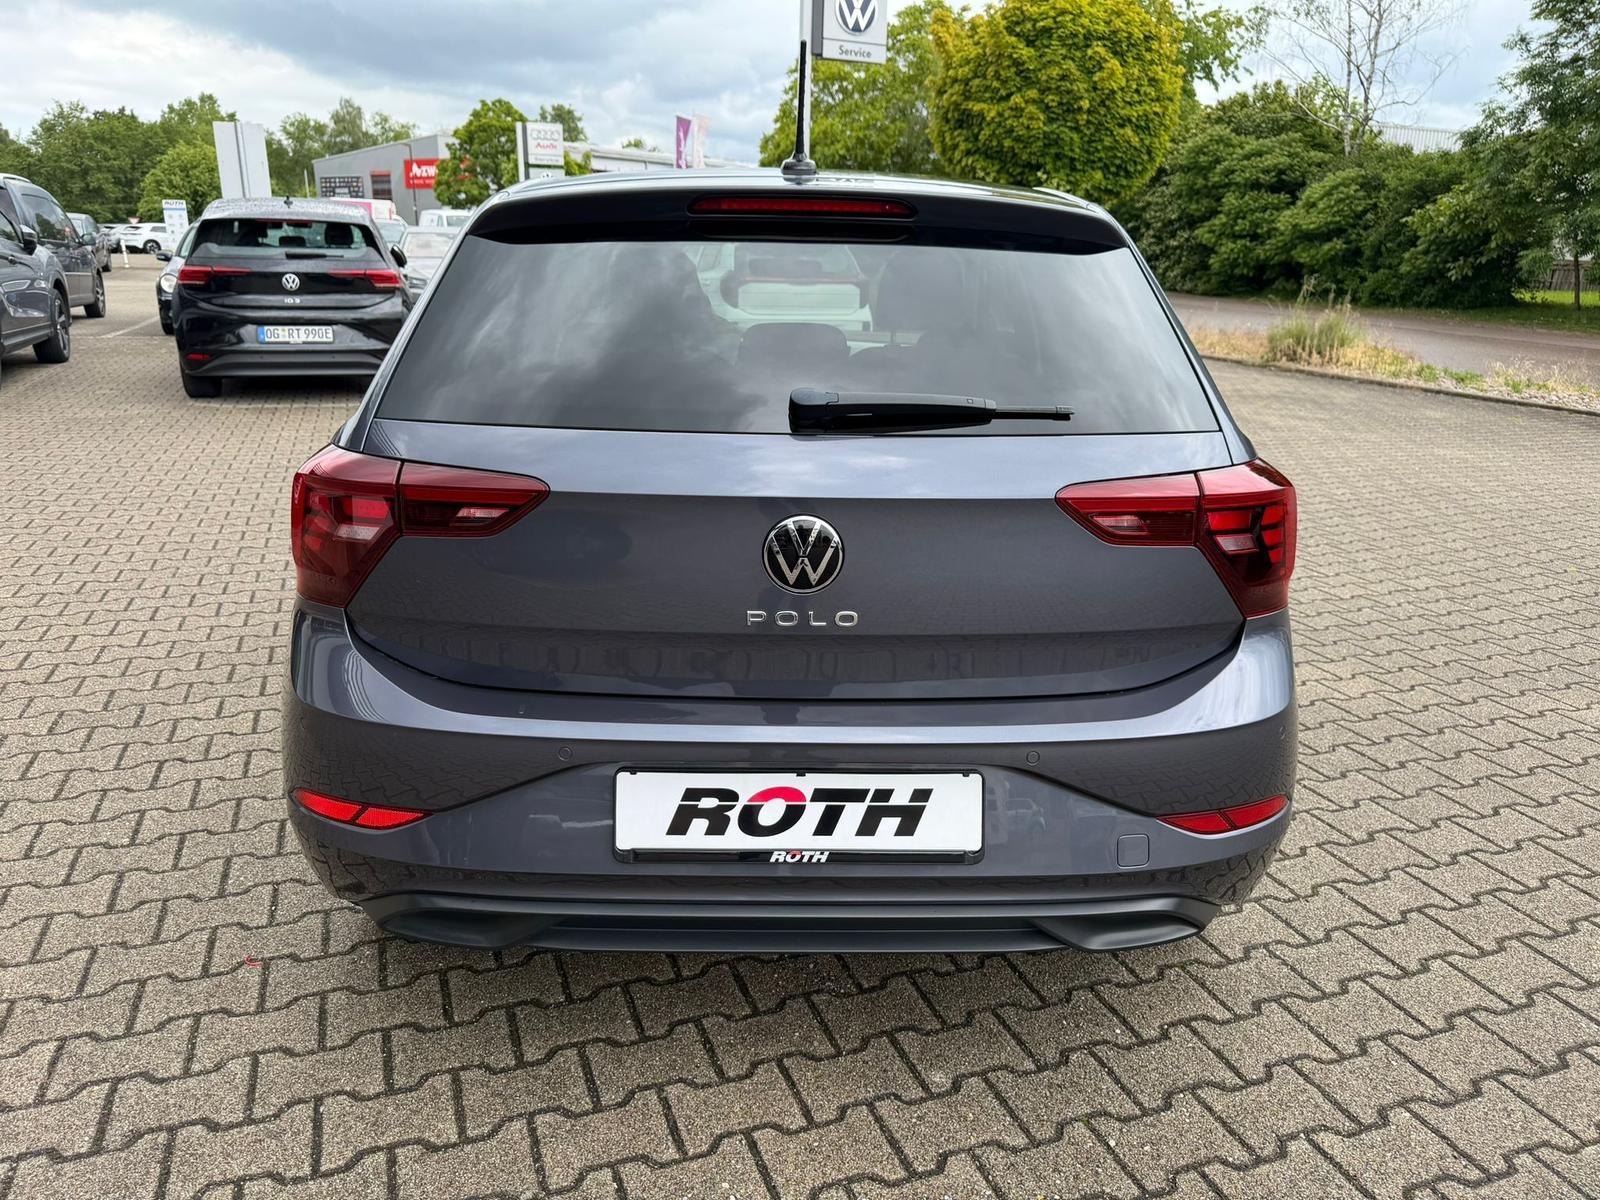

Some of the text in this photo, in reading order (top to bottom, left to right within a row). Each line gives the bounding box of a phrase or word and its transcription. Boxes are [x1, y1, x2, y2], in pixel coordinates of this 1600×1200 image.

[838, 45, 872, 58] Service
[535, 142, 557, 150] Audi
[266, 328, 331, 339] OG RT 990E
[762, 513, 845, 594] VW
[746, 610, 860, 627] POLO
[665, 786, 934, 837] ROTH
[769, 850, 829, 863] ROTH
